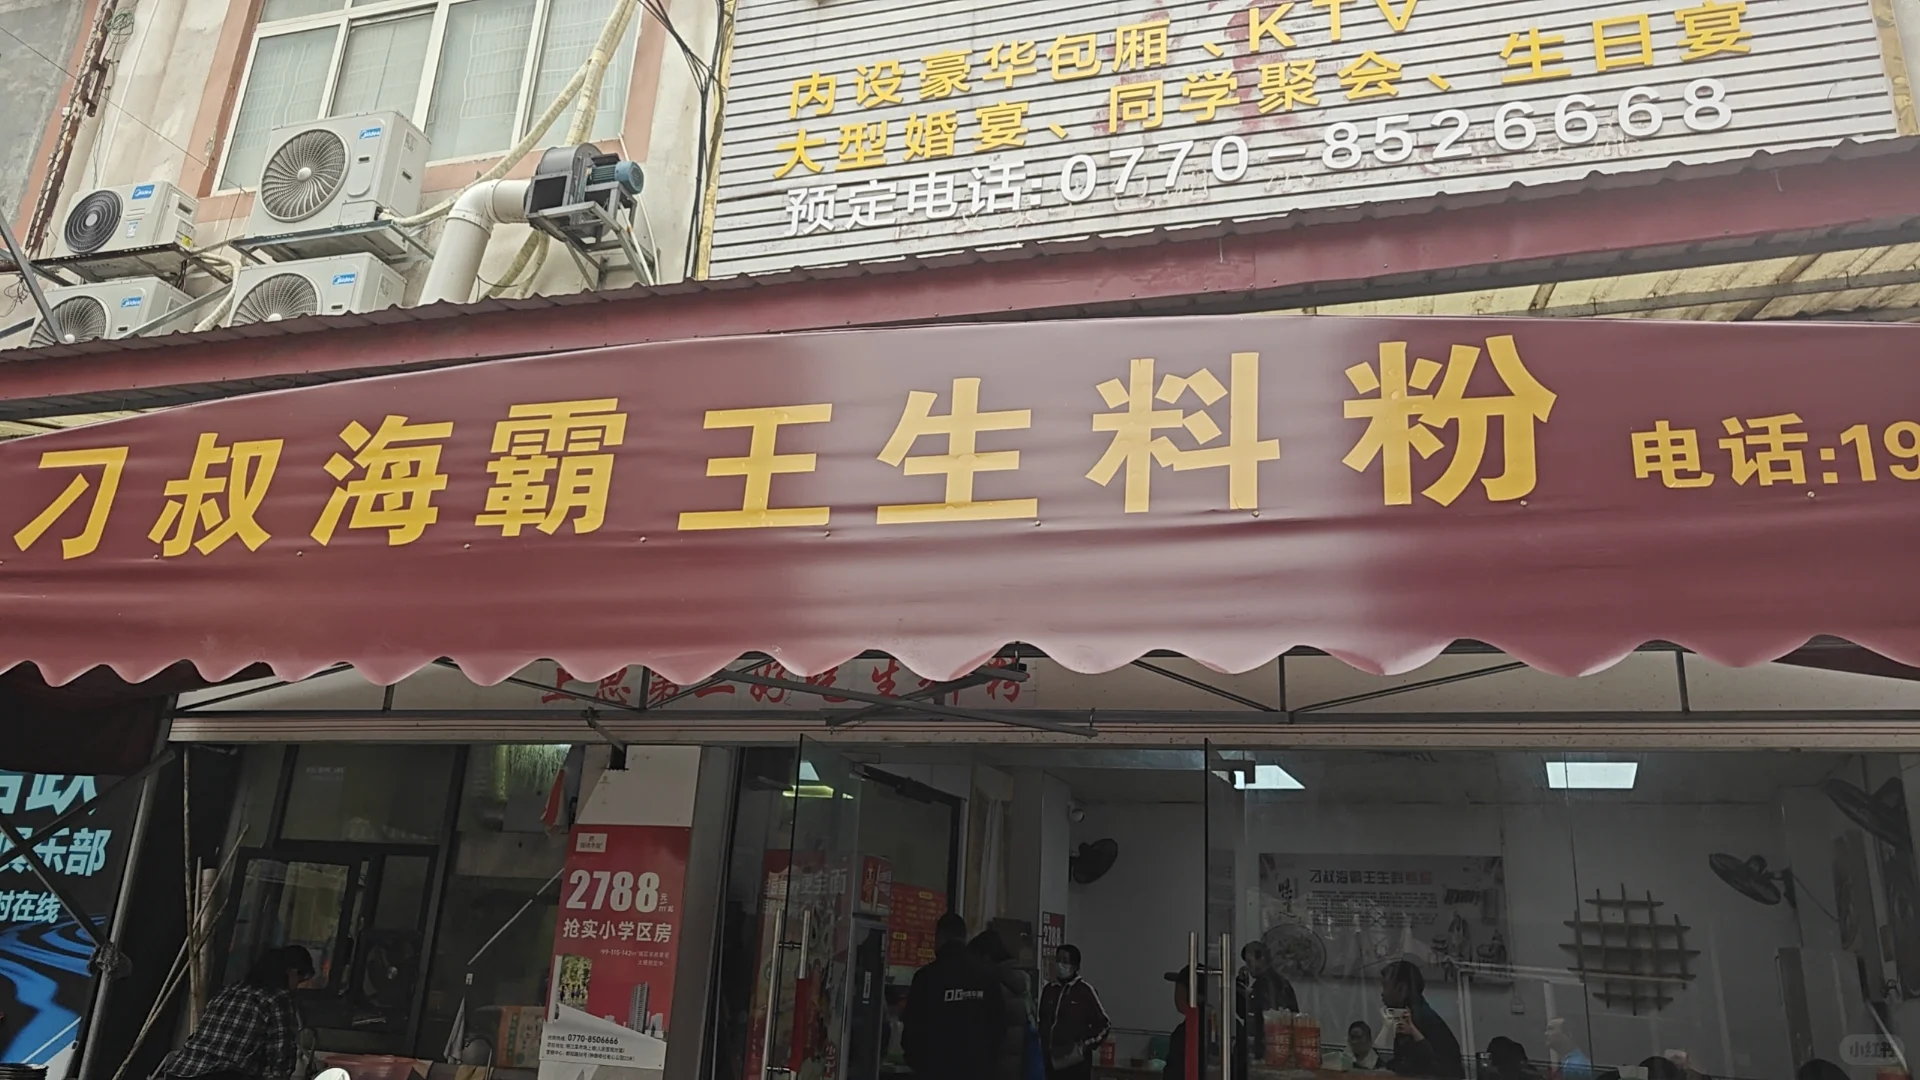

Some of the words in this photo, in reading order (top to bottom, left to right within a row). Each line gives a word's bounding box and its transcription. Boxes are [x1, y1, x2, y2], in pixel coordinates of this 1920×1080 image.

[774, 0, 1752, 180] 大型婚宴、同学聚会、生日宴
[13, 334, 1557, 561] 刁叔海霸王生料粉
[565, 869, 661, 914] 2788
[561, 917, 673, 944] 抢实小学区房
[567, 1033, 619, 1046] 0770-8506666
